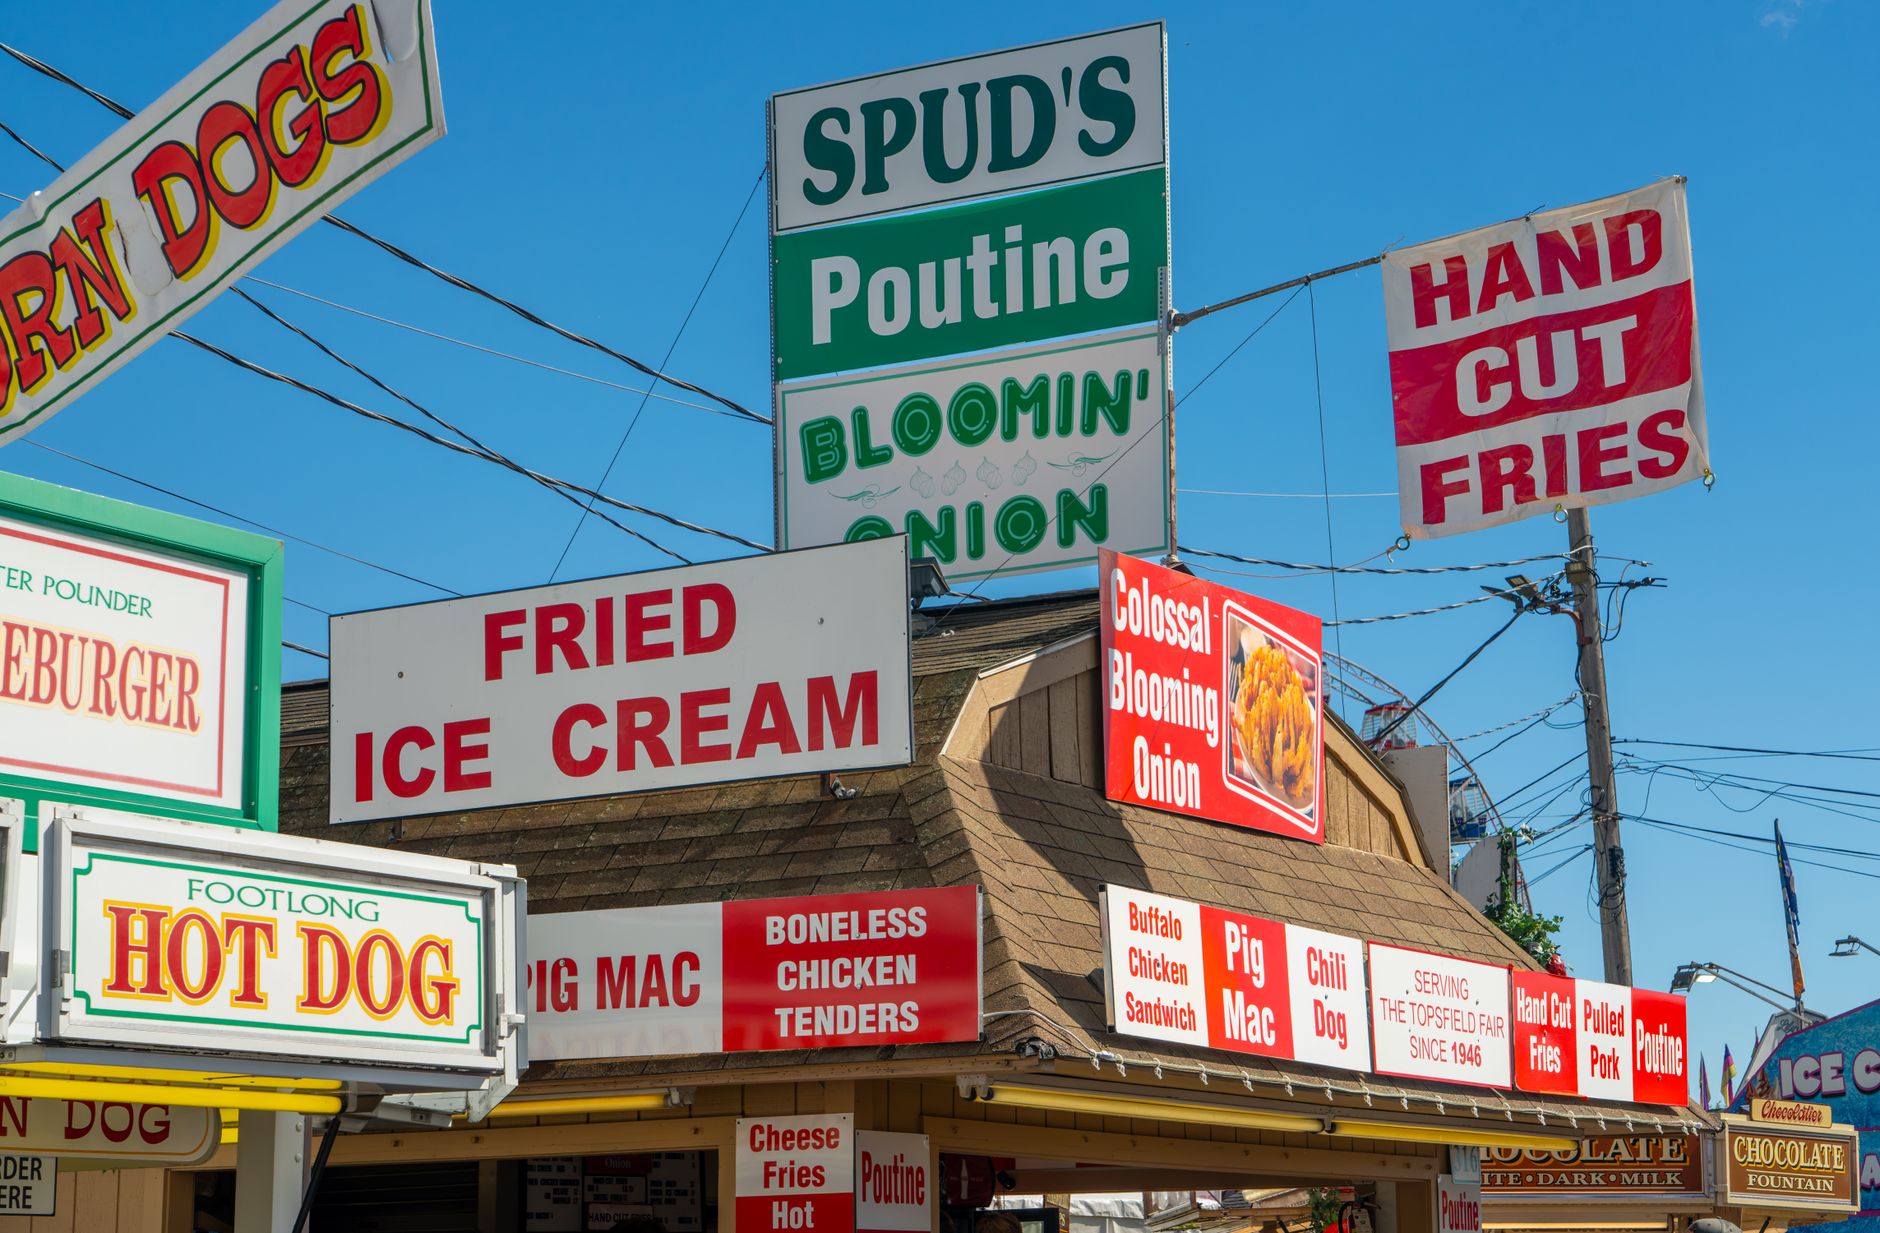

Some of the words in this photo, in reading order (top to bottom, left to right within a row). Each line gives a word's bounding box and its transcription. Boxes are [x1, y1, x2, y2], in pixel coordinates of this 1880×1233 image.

[802, 55, 1137, 206] SPUD'S
[0, 197, 138, 416] RN
[131, 3, 391, 280] DOGS
[810, 223, 1131, 345] Poutine
[1410, 208, 1663, 329] HAND
[1455, 314, 1638, 417] CUT
[799, 368, 1150, 484] BLOOMIN'
[1420, 409, 1690, 524] FRIES
[43, 575, 153, 619] POUNDER
[1110, 568, 1212, 655] Colossal
[484, 582, 737, 681] FRIED
[0, 619, 202, 733] EBURGER
[1108, 648, 1219, 747] Blooming
[355, 717, 492, 802] ICE
[551, 670, 878, 778] CREAM
[1133, 735, 1201, 809] Onion
[187, 877, 380, 923] FOOTLONG
[1128, 902, 1183, 941] Buffalo
[765, 906, 928, 945] BONELESS
[104, 900, 277, 1009] HOT
[296, 921, 459, 1025] DOG
[776, 954, 917, 991] CHICKEN
[1128, 946, 1189, 986] Chicken
[1224, 920, 1265, 989] Pig
[1306, 946, 1347, 991] Chili
[596, 951, 701, 1009] MAC
[1414, 969, 1469, 1001] SERVING
[774, 1000, 920, 1038] TENDERS
[1125, 991, 1197, 1032] Sandwich
[1222, 988, 1276, 1047] Mac
[1313, 999, 1348, 1050] Dog
[1380, 997, 1407, 1024] THE
[1409, 1002, 1477, 1034] TOPSFIELD
[1479, 1013, 1506, 1039] FAIR
[1516, 986, 1549, 1027] Hand
[1550, 992, 1572, 1030] Cut
[1584, 999, 1625, 1038] Pulled
[1410, 1034, 1448, 1063] SINCE
[1451, 1041, 1482, 1068] 1946
[1529, 1035, 1561, 1074] Fries
[1590, 1044, 1620, 1081] Pork
[1635, 1019, 1684, 1078] Poutine
[1779, 1052, 1846, 1099] ICE
[63, 1099, 171, 1145] DOG
[1761, 1100, 1823, 1124] Chocolatier
[749, 1123, 841, 1153] Cheese
[1733, 1135, 1845, 1172] CHOCOLATE
[0, 1156, 42, 1181] DER
[763, 1159, 826, 1189] Fries
[861, 1150, 925, 1207] Poutine
[1536, 1172, 1608, 1186] DARK
[1619, 1172, 1683, 1186] MILK
[1747, 1173, 1835, 1192] FOUNTAIN
[772, 1199, 815, 1230] Hot
[1442, 1190, 1479, 1232] Poutine
